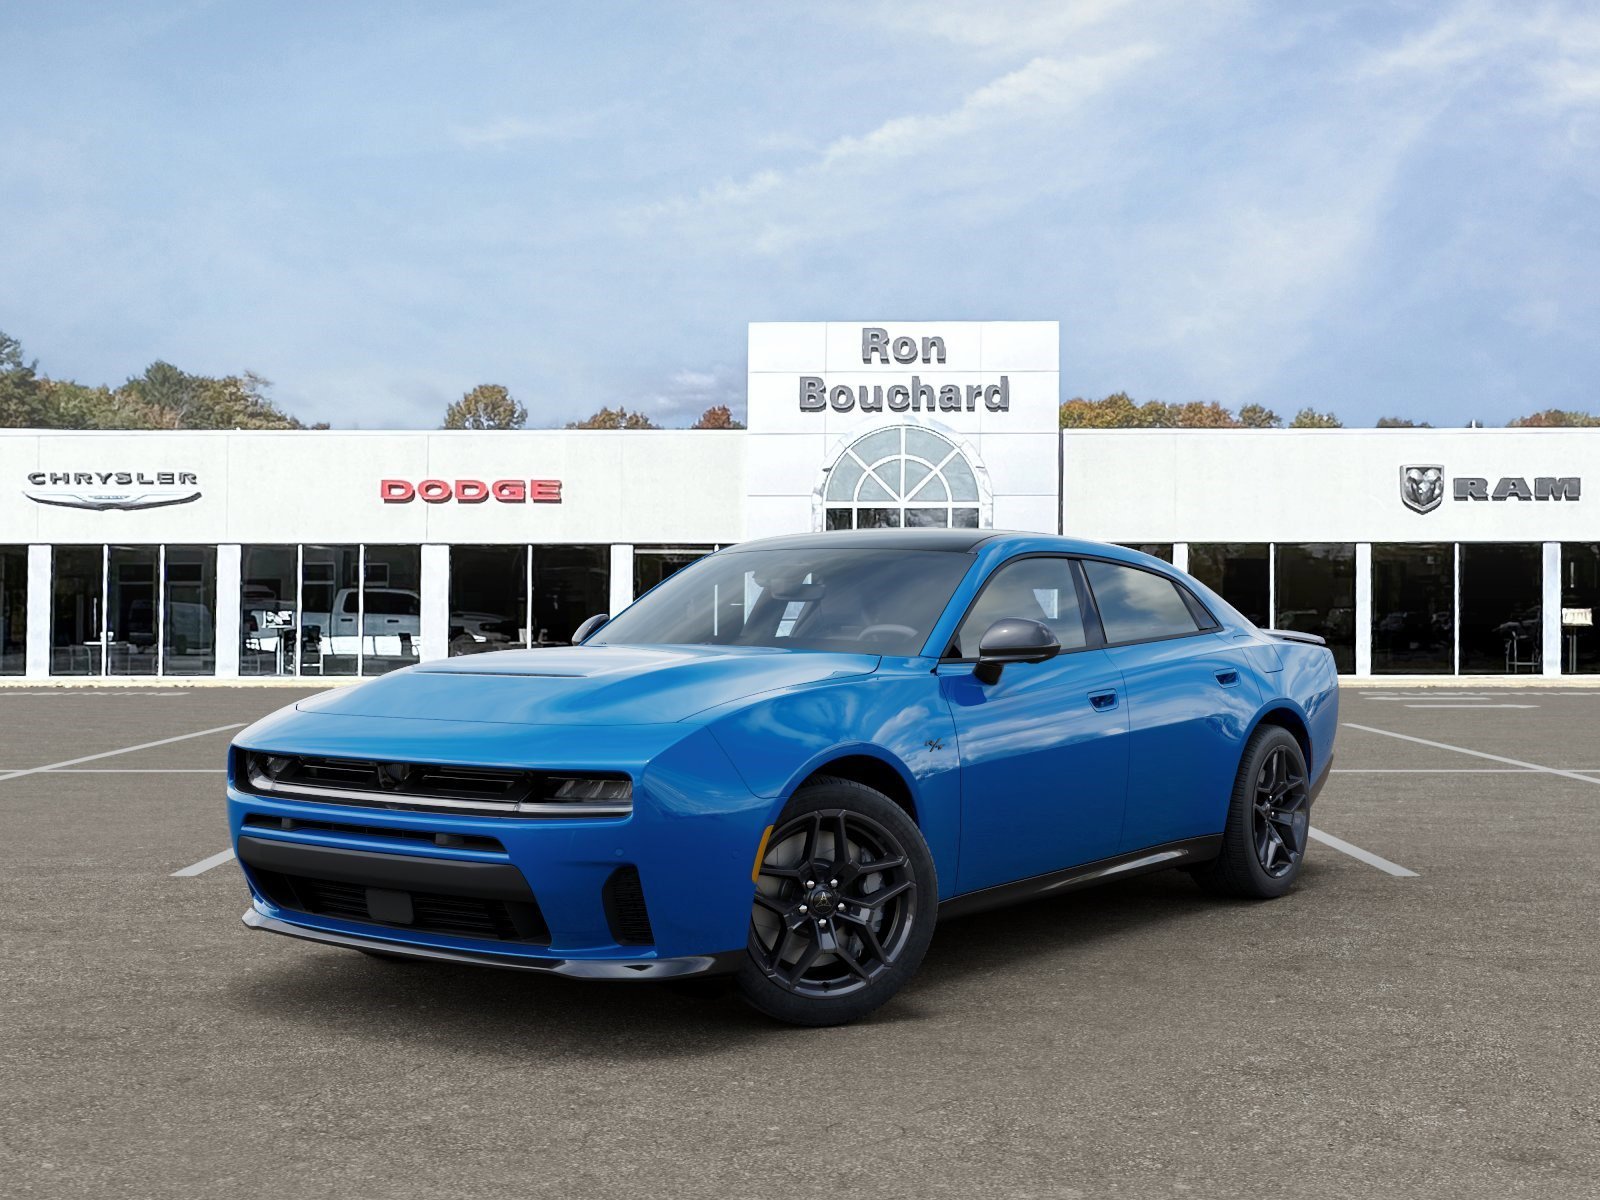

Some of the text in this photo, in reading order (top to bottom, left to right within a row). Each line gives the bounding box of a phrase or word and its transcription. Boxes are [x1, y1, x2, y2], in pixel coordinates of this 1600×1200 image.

[862, 327, 946, 364] Ron
[799, 376, 1010, 413] Bouchard
[27, 471, 198, 486] CHRYSLER
[1453, 477, 1581, 501] RAM
[381, 479, 562, 504] DODGE
